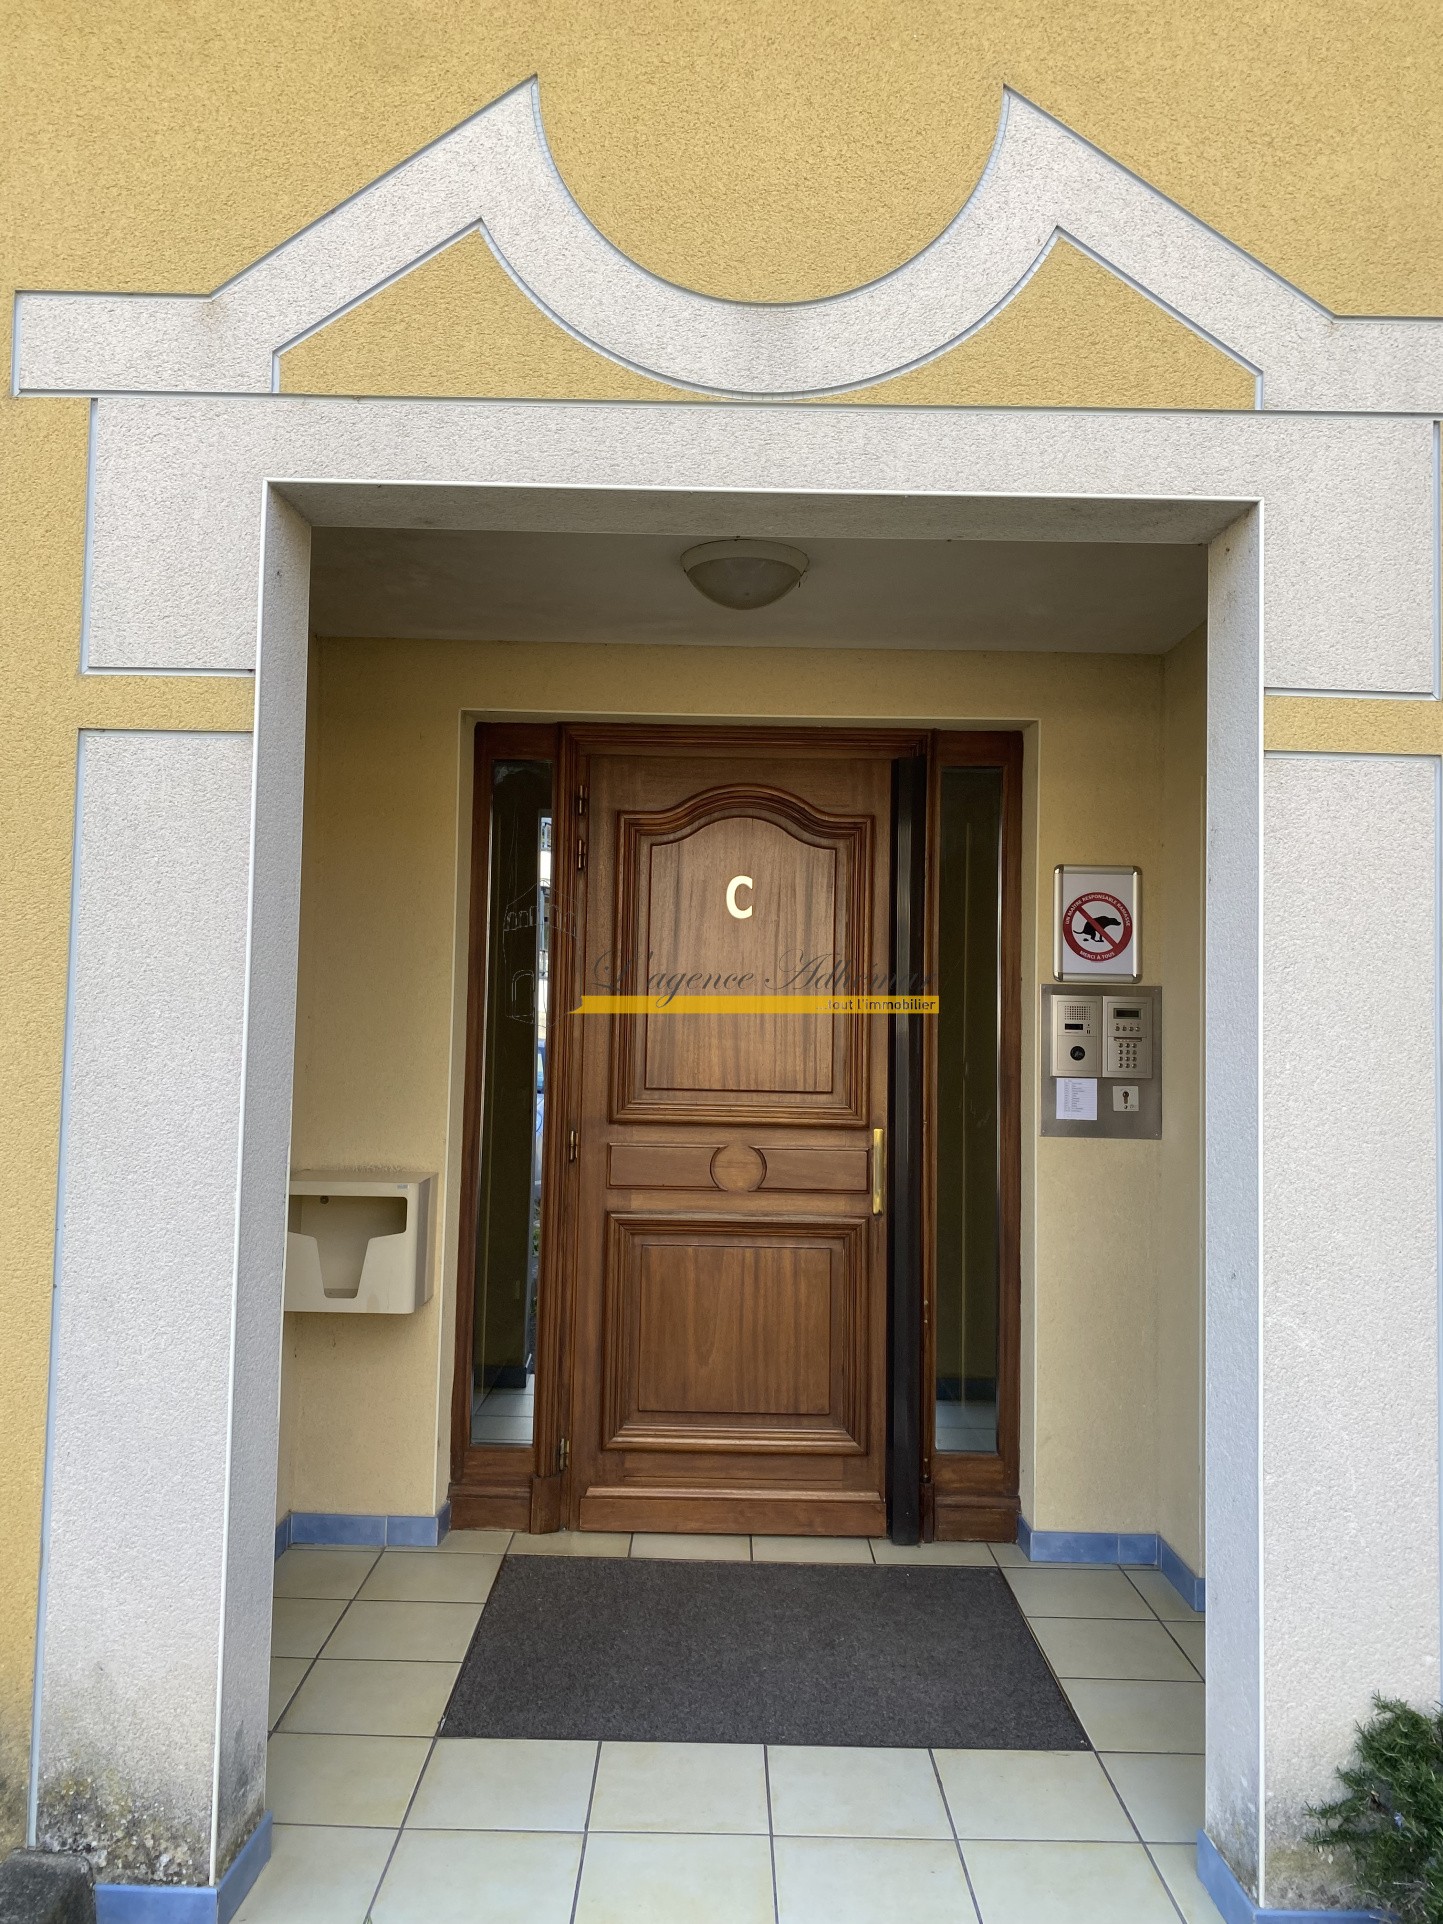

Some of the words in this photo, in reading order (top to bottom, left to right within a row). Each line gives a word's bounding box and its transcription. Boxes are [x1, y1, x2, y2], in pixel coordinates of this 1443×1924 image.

[726, 875, 753, 919] C
[1082, 894, 1118, 905] RESPONSABLE
[1117, 903, 1130, 926] RAMASSE
[1079, 950, 1095, 959] MERCI
